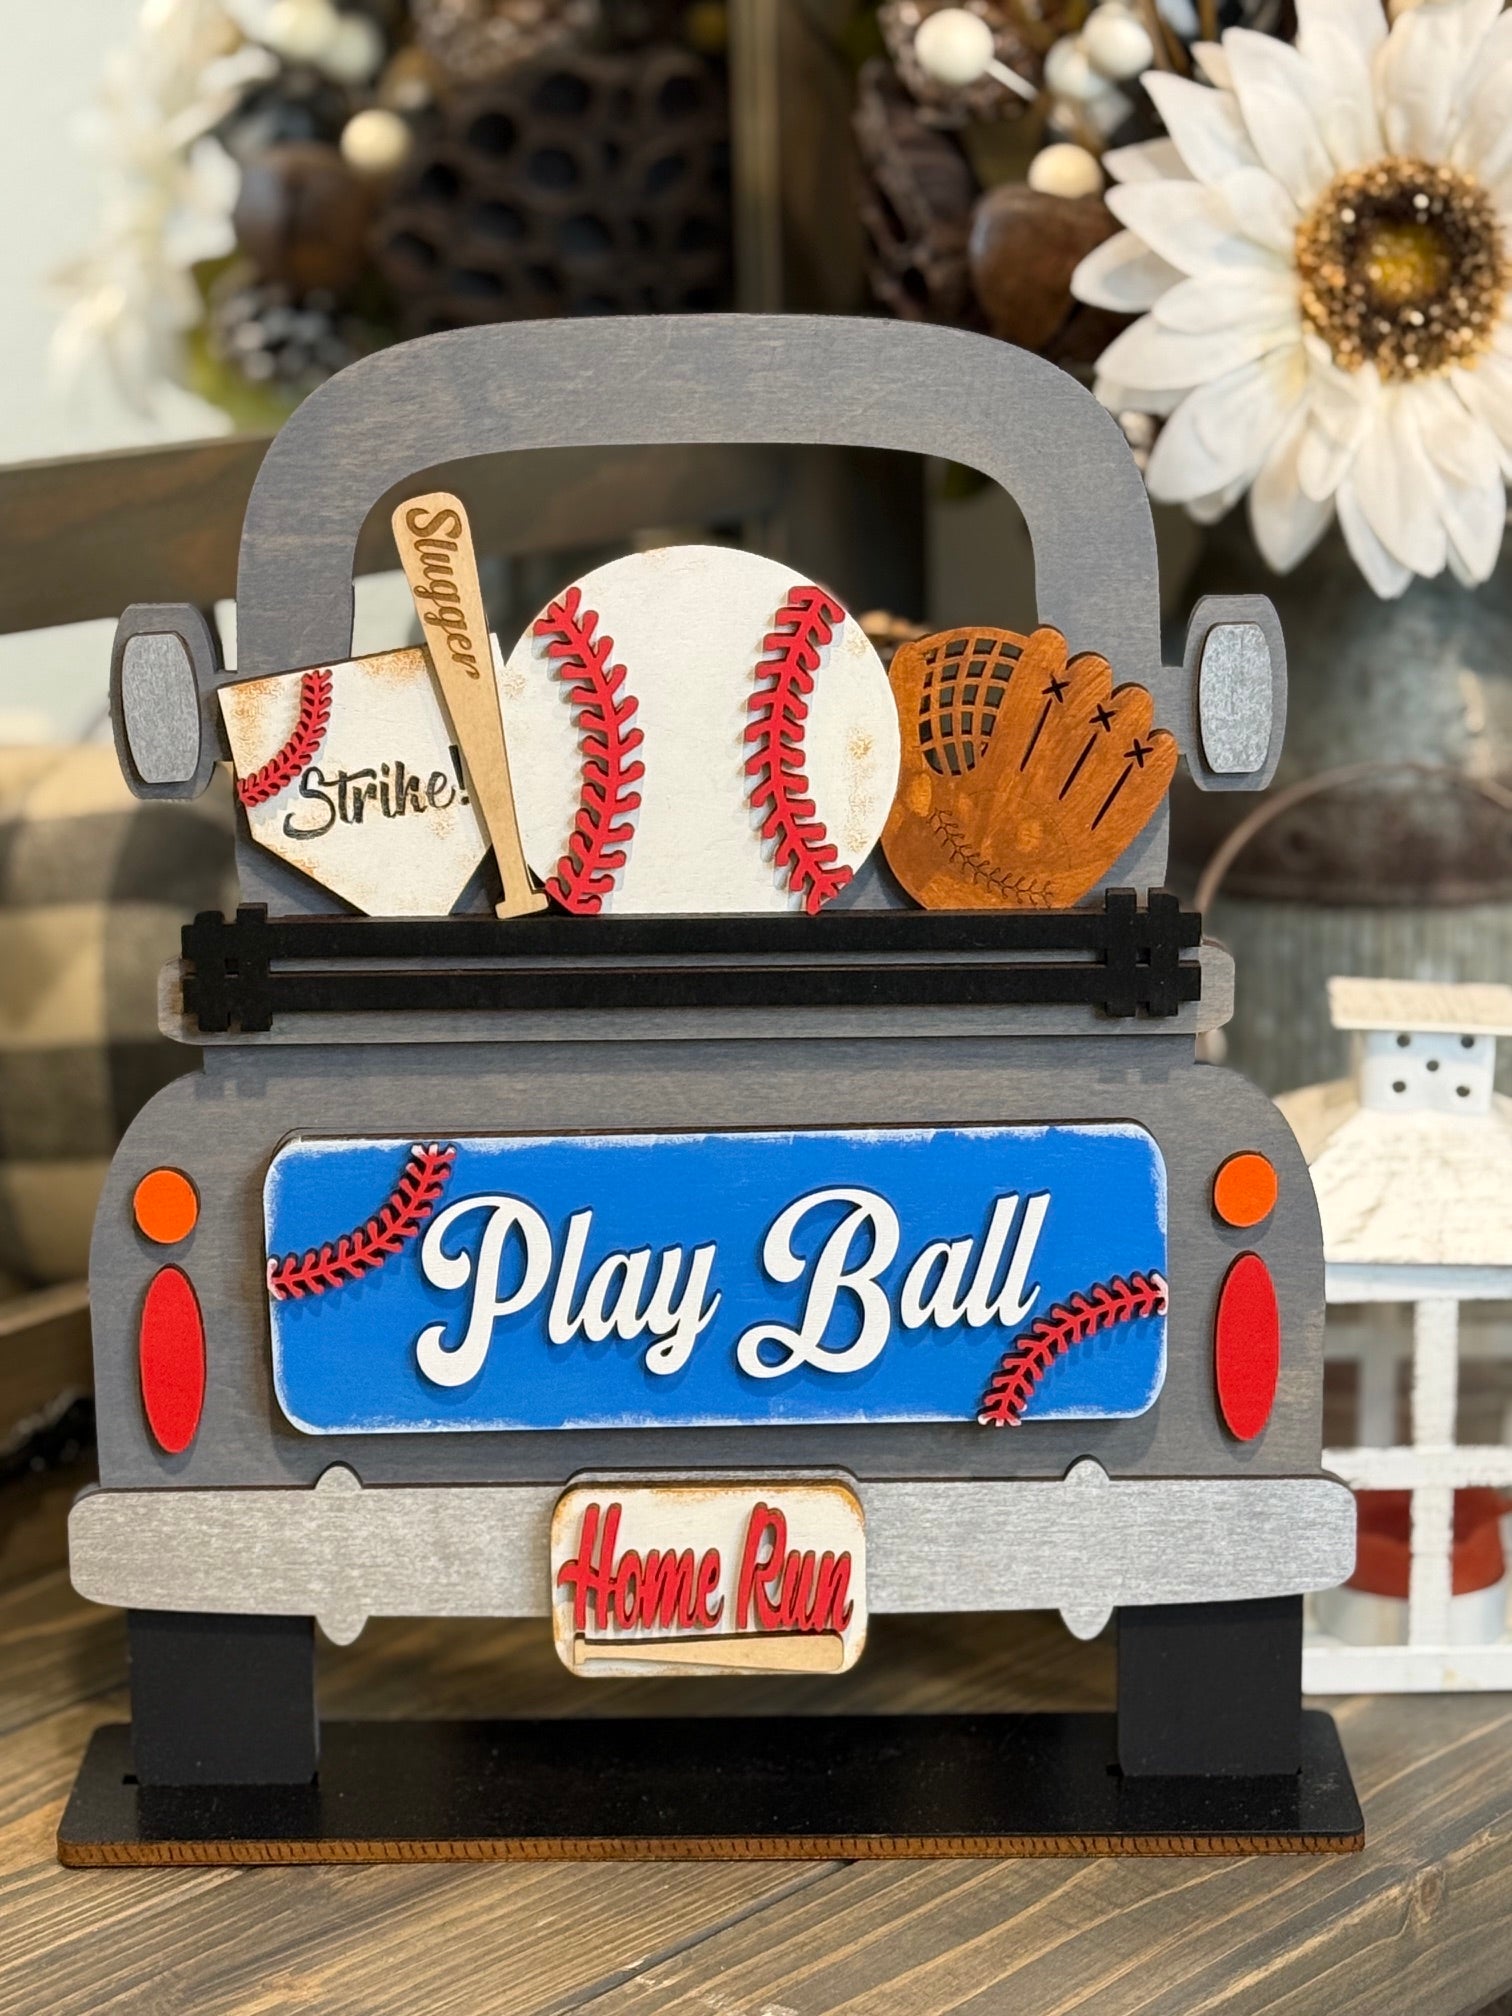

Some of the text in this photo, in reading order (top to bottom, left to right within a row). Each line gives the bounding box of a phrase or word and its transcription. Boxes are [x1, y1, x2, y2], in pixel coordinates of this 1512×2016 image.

[405, 507, 481, 680] Slugger
[282, 744, 471, 840] Strike!
[415, 1185, 1052, 1387] Play Ball
[556, 1501, 854, 1632] Home Run
